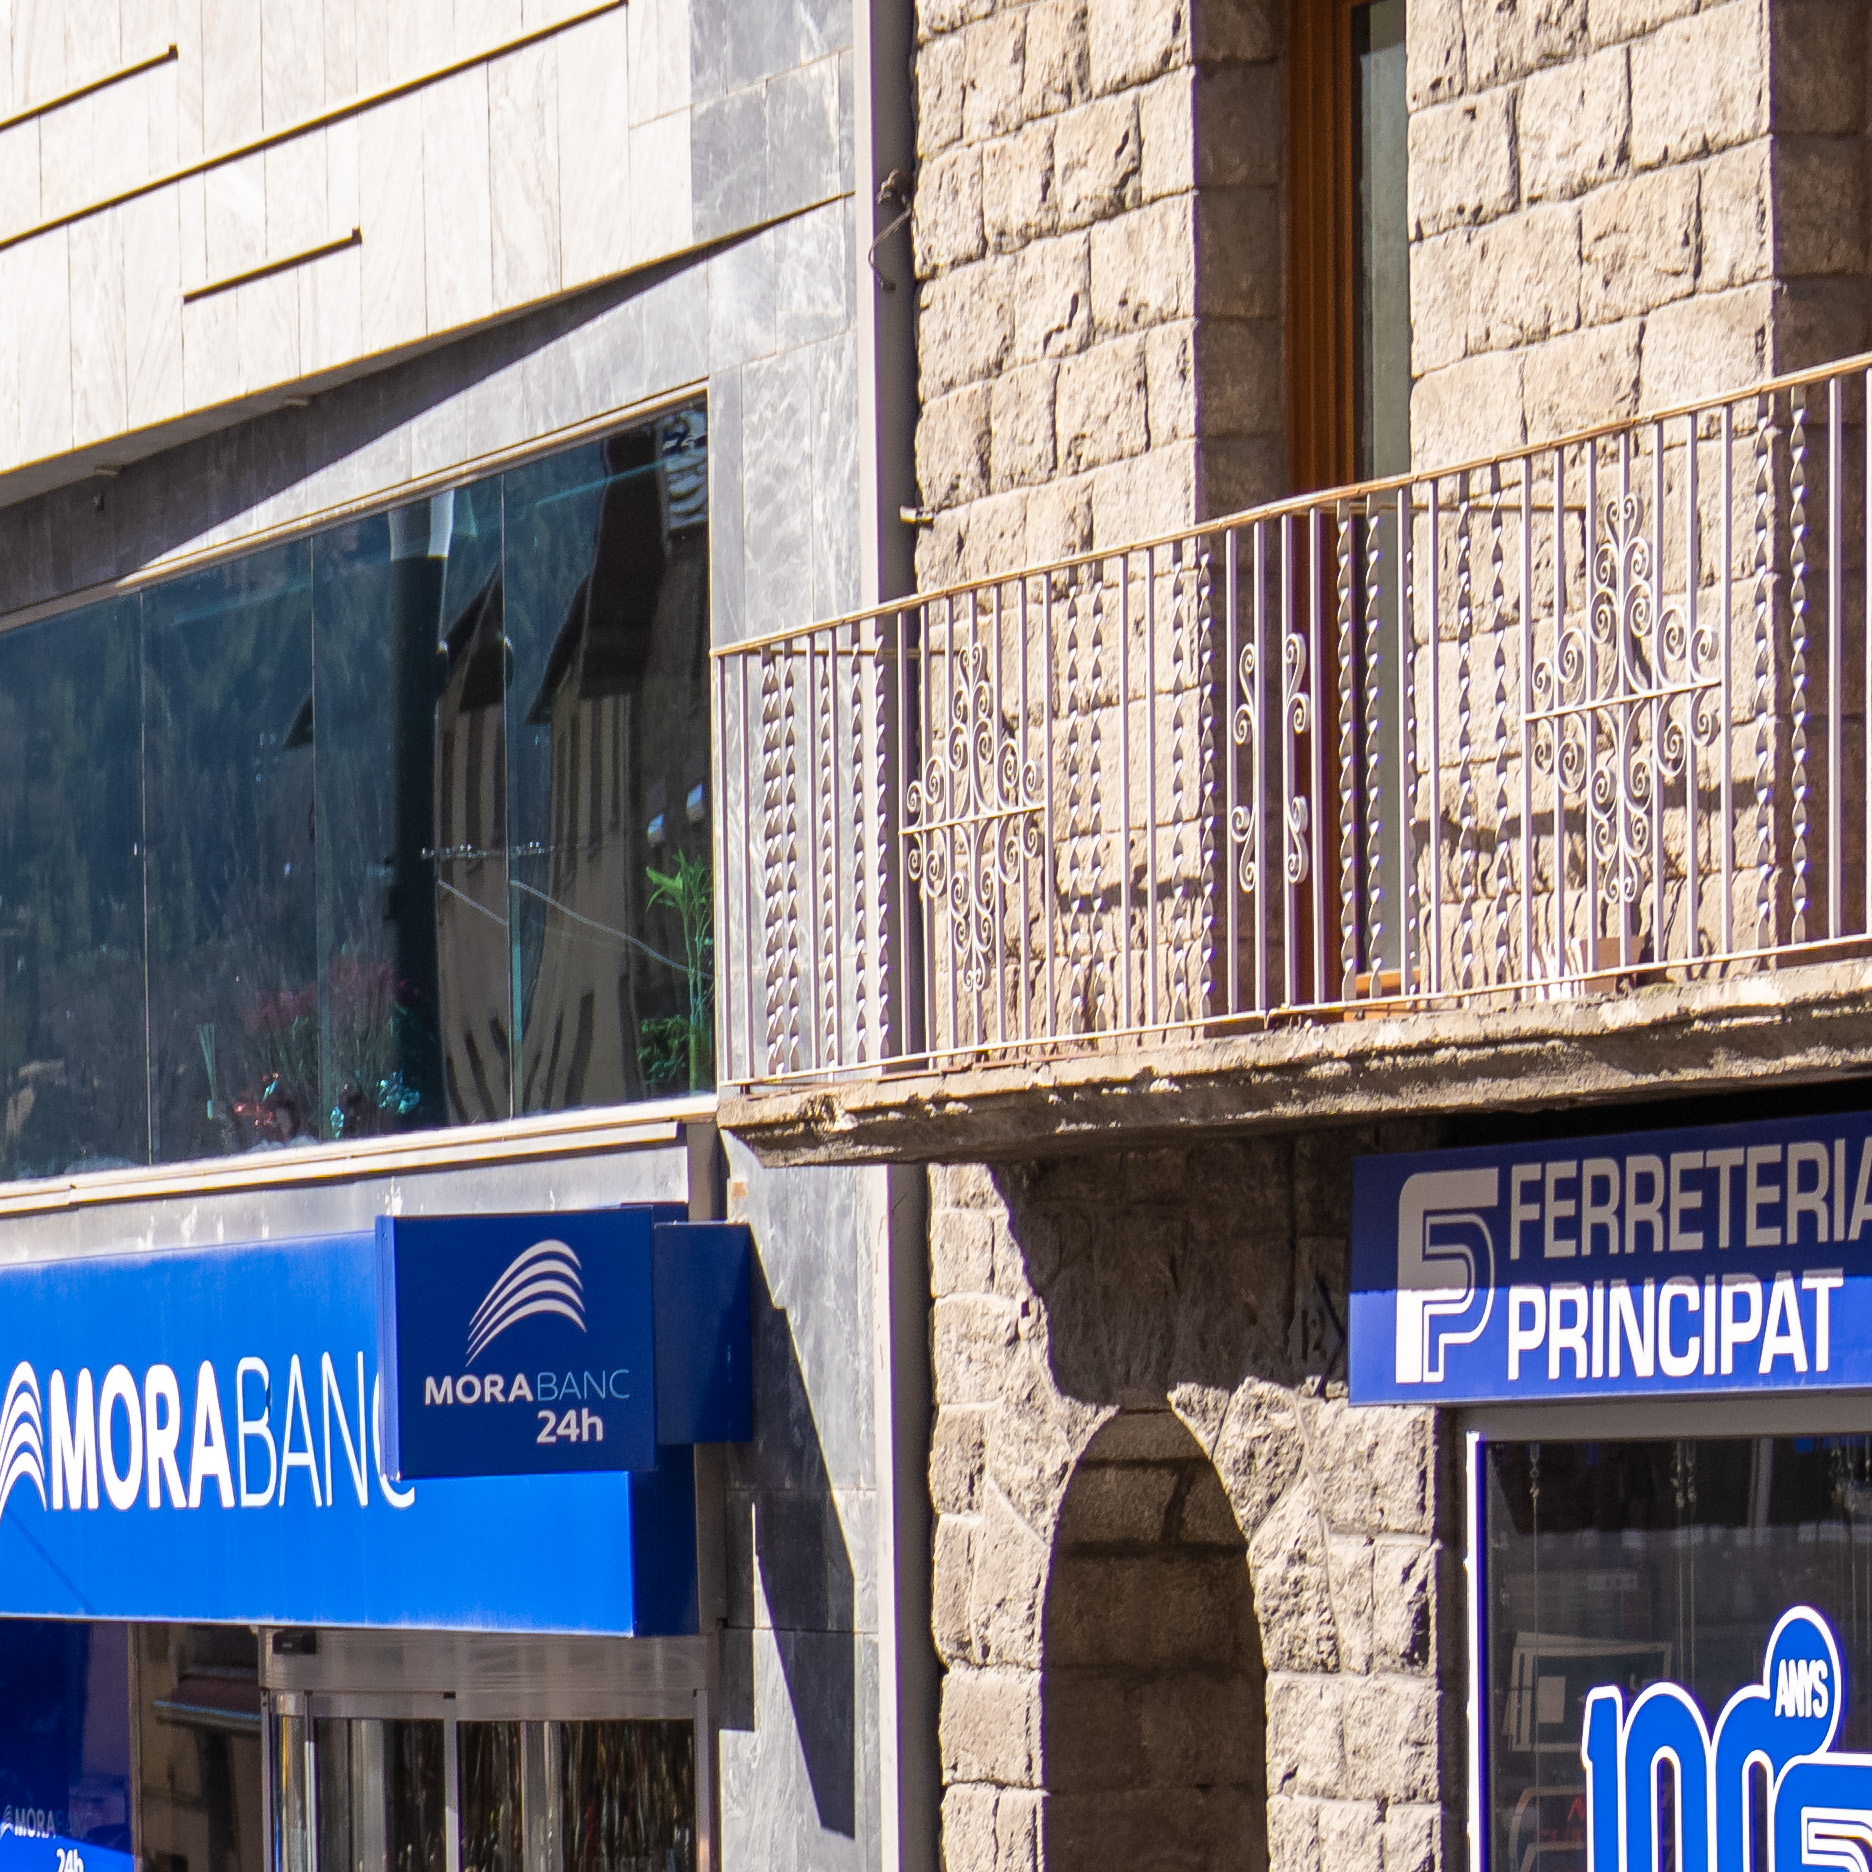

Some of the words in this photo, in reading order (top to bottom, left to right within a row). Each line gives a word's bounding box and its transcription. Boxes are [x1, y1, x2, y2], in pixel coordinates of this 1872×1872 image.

[1507, 1267, 1844, 1381] PRINCIPAT
[424, 1368, 630, 1406] MORABANC
[536, 1407, 604, 1445] 24h
[1774, 1658, 1829, 1718] ANYS
